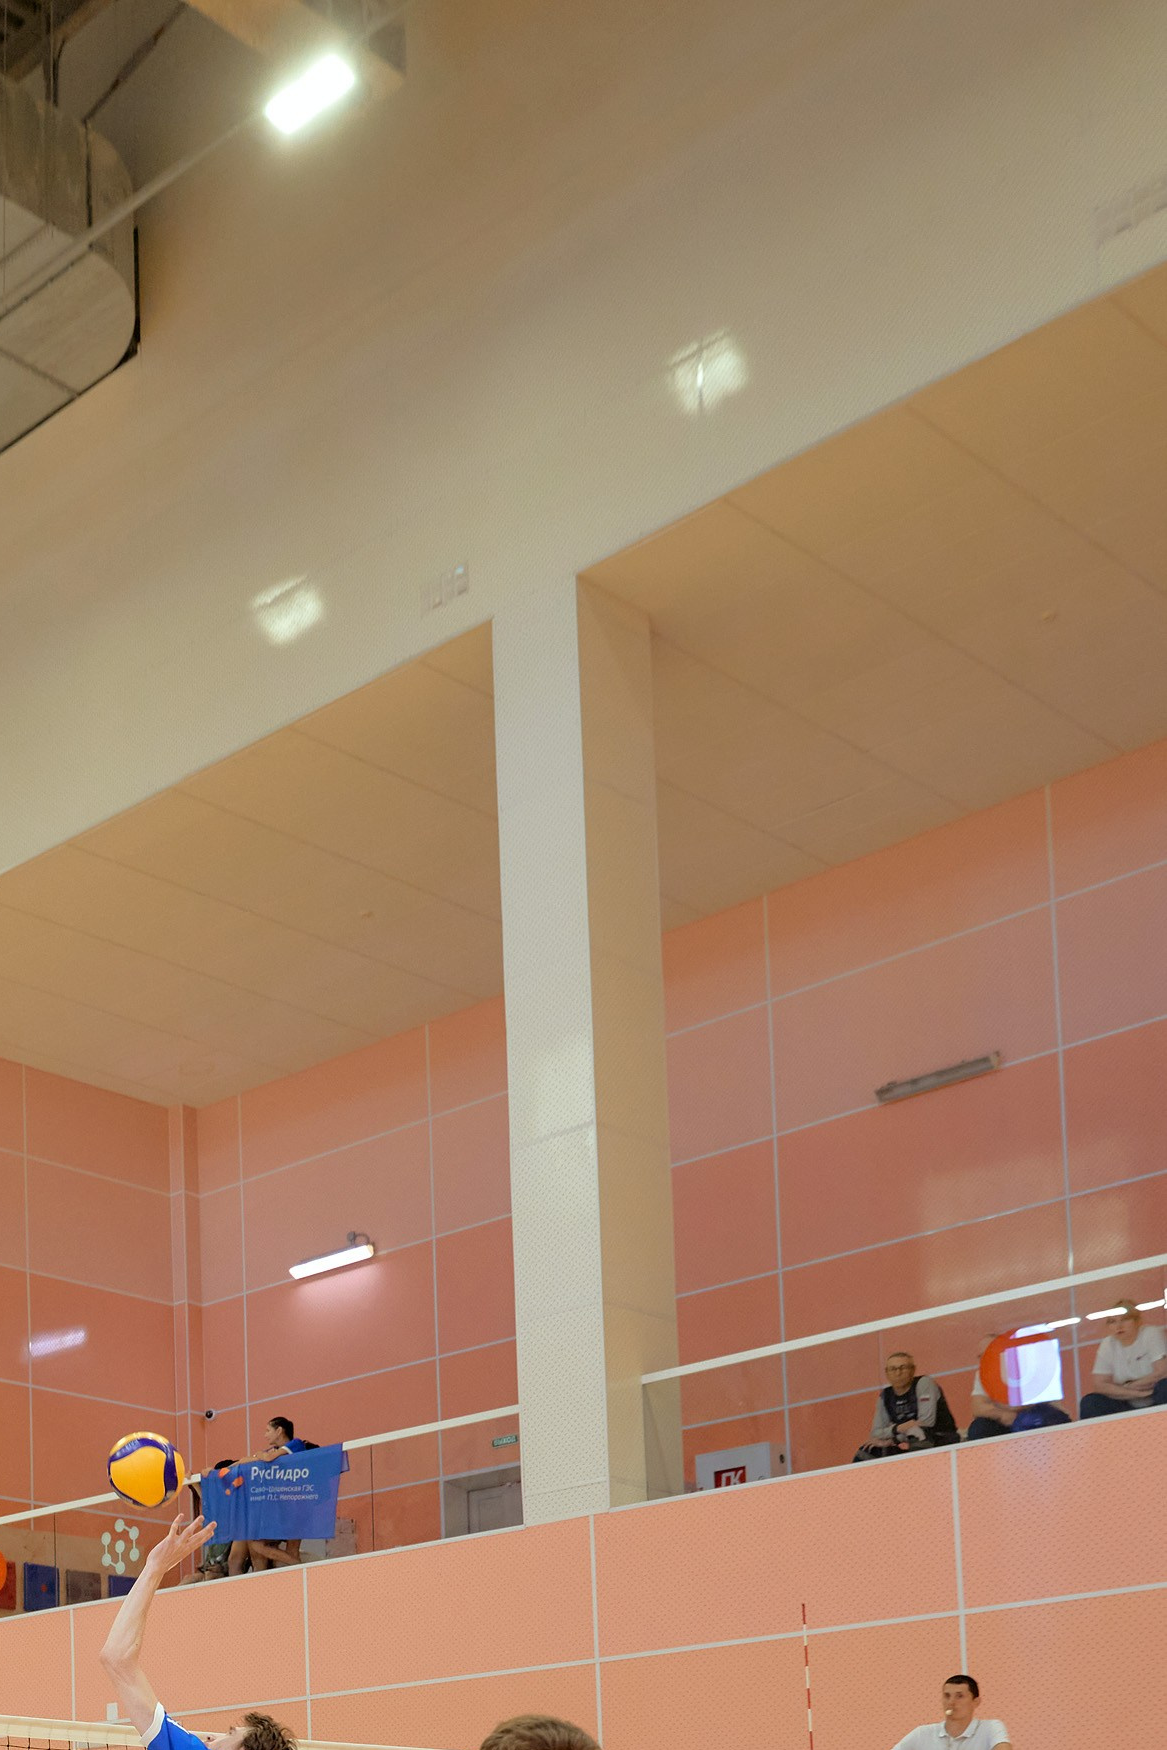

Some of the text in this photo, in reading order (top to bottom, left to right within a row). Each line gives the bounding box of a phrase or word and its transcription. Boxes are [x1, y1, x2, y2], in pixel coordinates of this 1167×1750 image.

[251, 1466, 309, 1483] РусГидро
[721, 1469, 744, 1487] ПК
[302, 1484, 314, 1492] ГЭС
